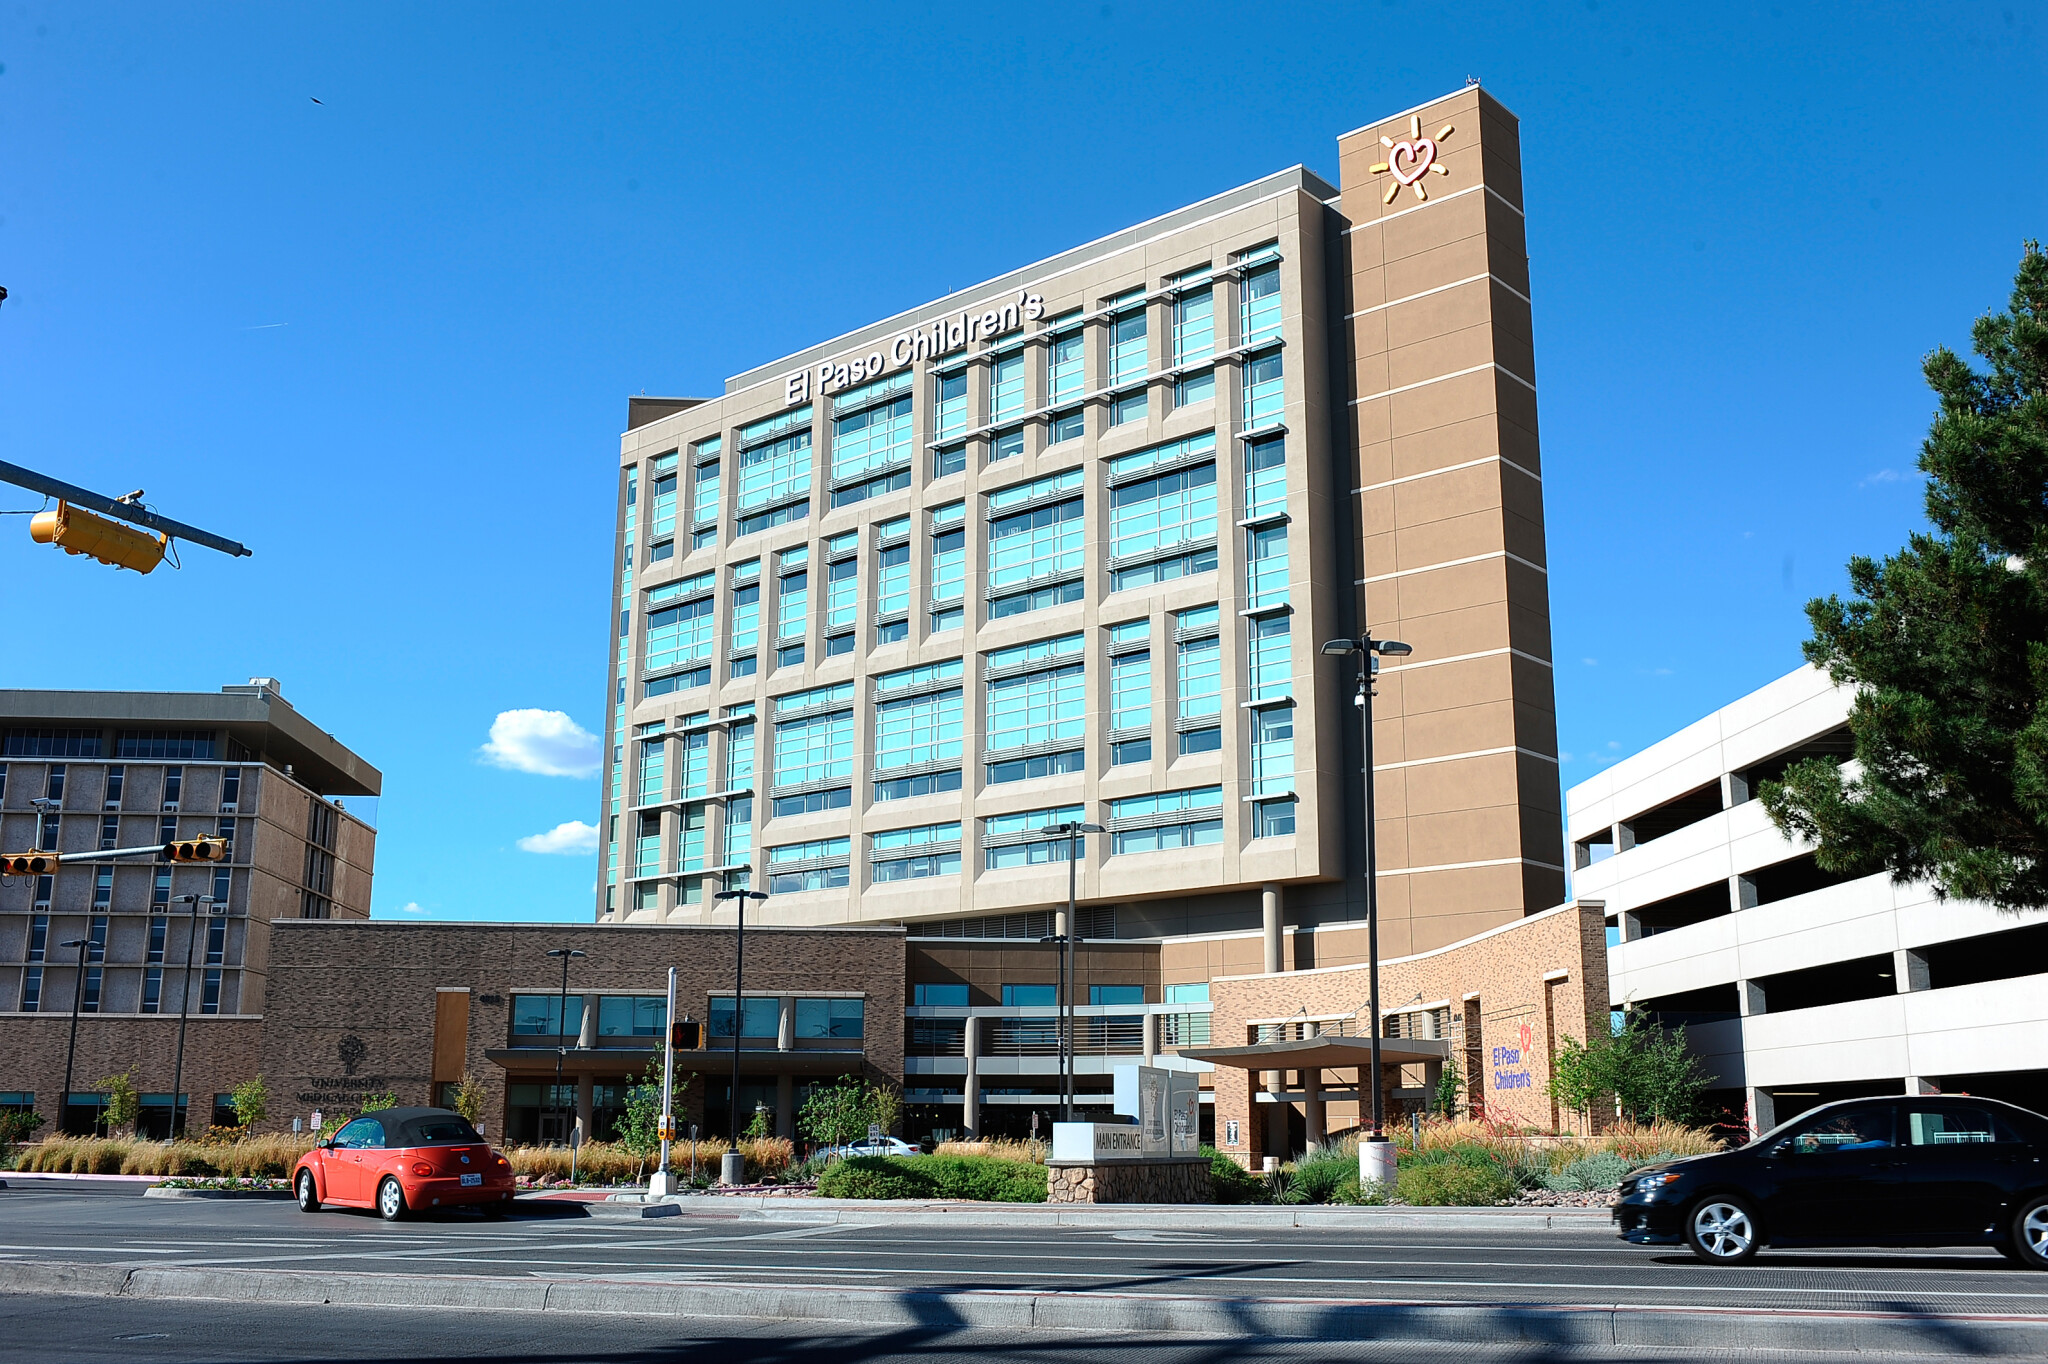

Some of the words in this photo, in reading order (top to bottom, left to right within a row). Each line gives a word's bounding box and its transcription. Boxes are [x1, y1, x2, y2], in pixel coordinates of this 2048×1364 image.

[785, 371, 811, 405] El
[817, 351, 884, 395] Paso
[891, 290, 1044, 367] Children's
[1493, 1048, 1500, 1067] El
[1502, 1046, 1519, 1065] Paso
[312, 1078, 385, 1088] UNIVERSITY
[1495, 1069, 1530, 1090] Children's
[296, 1092, 349, 1102] MEDICAL
[1096, 1132, 1111, 1149] MAIN
[1112, 1133, 1141, 1149] ENTRANCE
